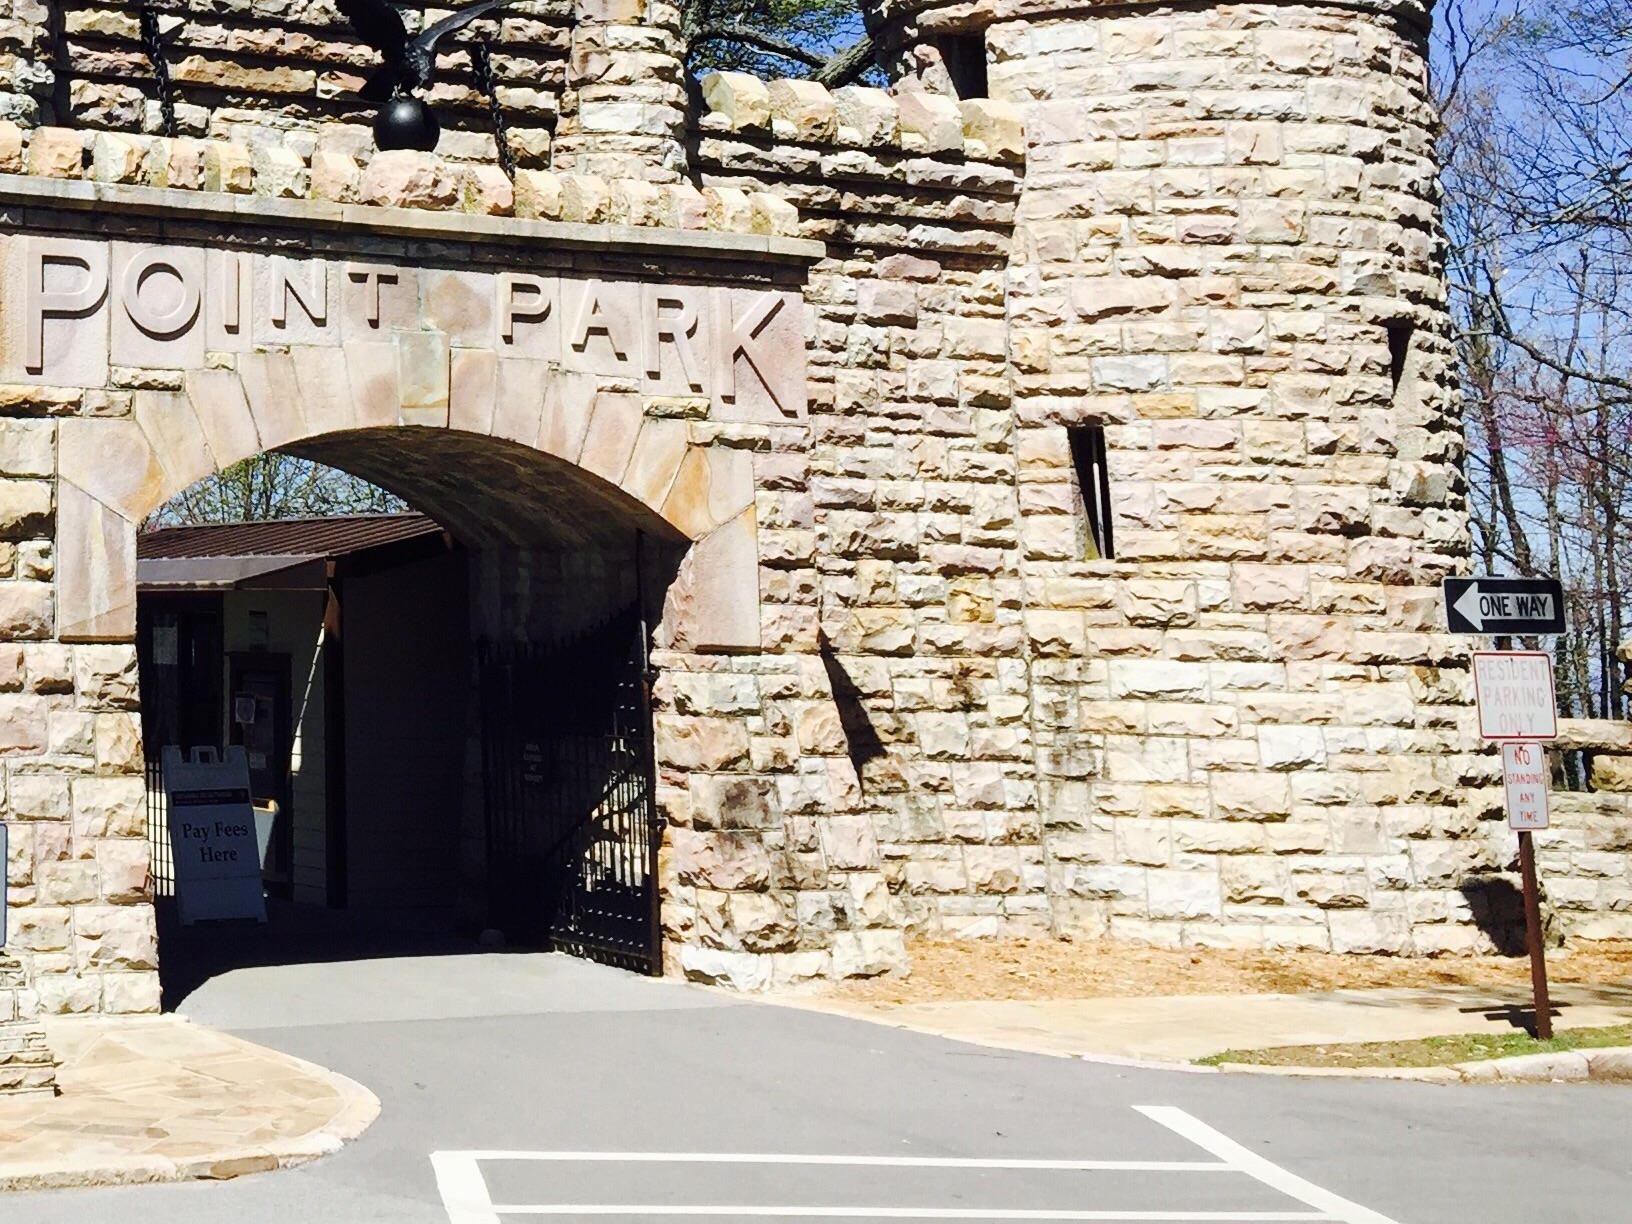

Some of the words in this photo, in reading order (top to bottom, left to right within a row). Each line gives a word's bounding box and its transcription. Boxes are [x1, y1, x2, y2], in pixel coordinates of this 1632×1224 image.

[24, 239, 399, 375] POINT
[498, 272, 799, 418] PARK
[1479, 595, 1512, 617] ONE
[1516, 595, 1548, 617] WAY
[1478, 660, 1548, 681] RESIDENT
[1483, 686, 1546, 708] PARKING
[1498, 713, 1536, 734] ONLY
[1513, 749, 1531, 766] NO
[1507, 773, 1545, 785] STANDING
[1519, 792, 1535, 804] ANY
[1519, 811, 1539, 823] TIME
[182, 823, 209, 843] Pay
[215, 822, 249, 837] Fees
[199, 846, 238, 863] Here
